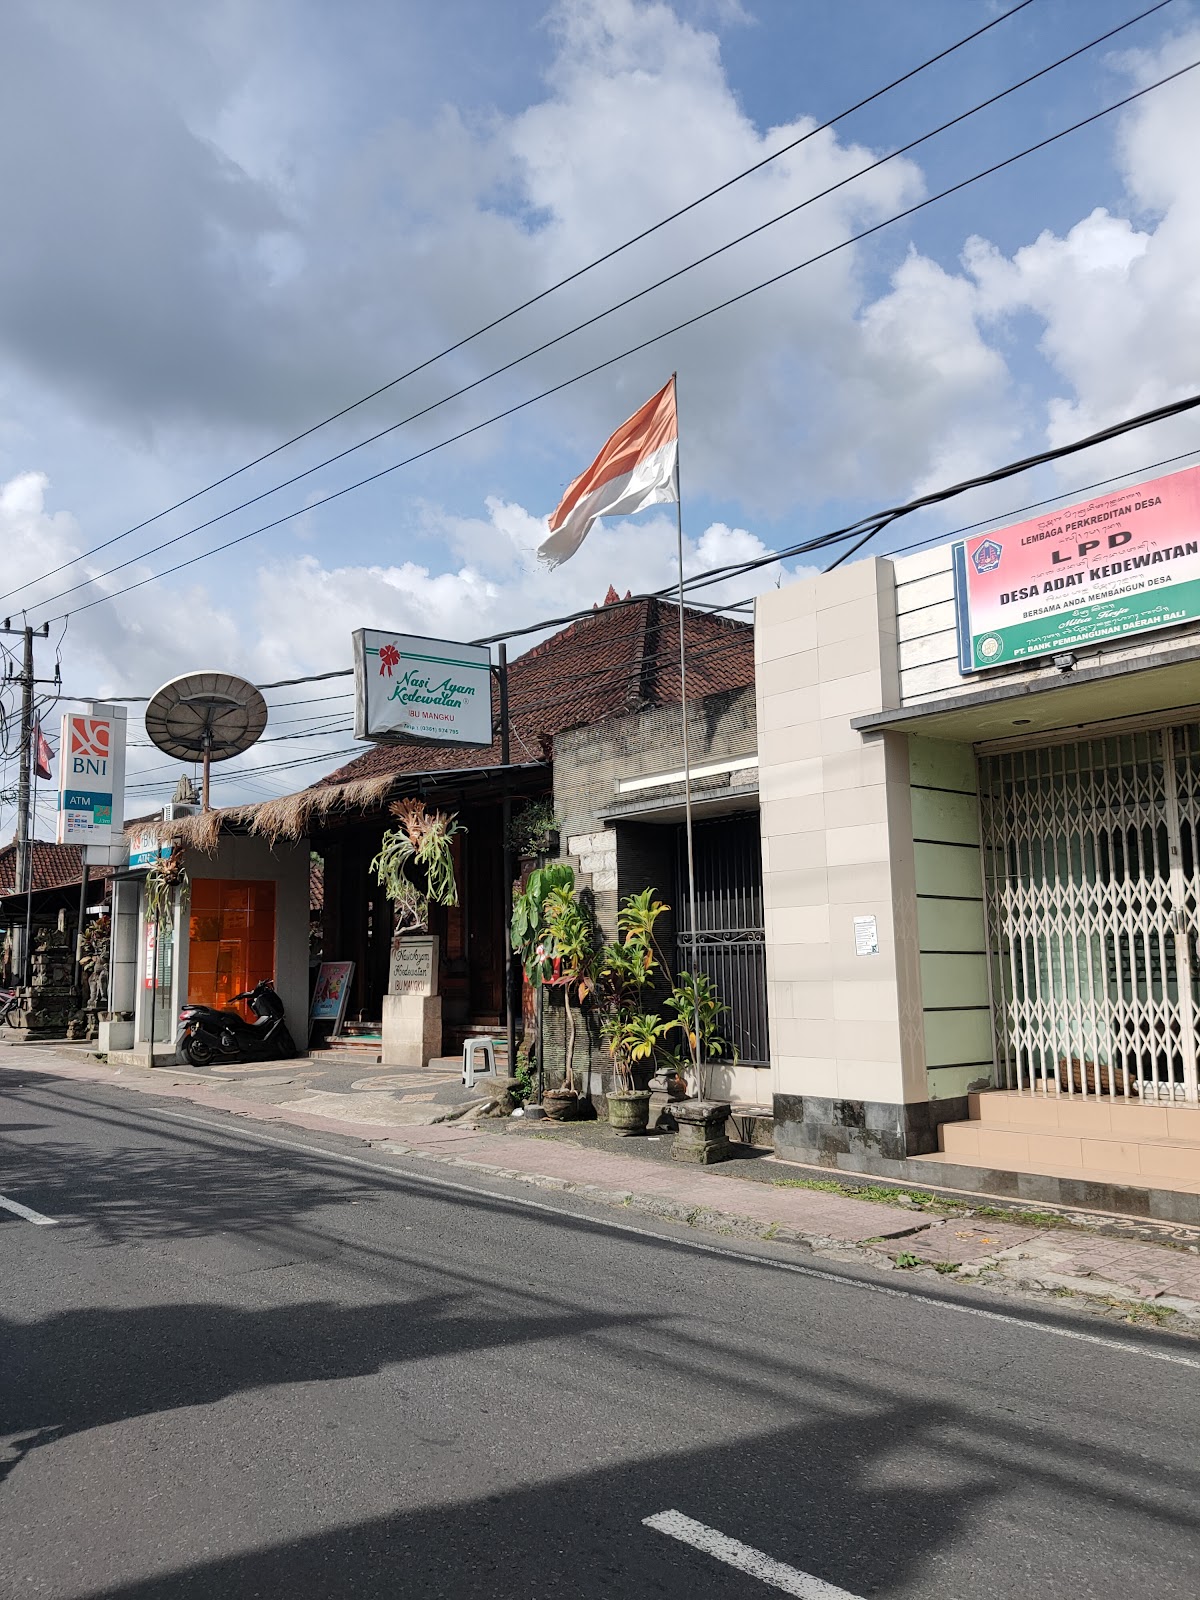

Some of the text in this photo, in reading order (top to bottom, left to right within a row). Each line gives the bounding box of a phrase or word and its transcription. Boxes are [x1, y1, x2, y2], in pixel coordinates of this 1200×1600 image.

[1021, 526, 1063, 546] LEMBAGA
[1065, 504, 1132, 533] PERKREDITAN
[1134, 496, 1162, 512] DESA
[1000, 584, 1039, 606] DESA
[1042, 571, 1085, 594] ADAT
[1089, 540, 1198, 581] KEDEWATAN
[1022, 604, 1061, 619] BERSAMA
[1063, 597, 1086, 608] ANDA
[1088, 581, 1145, 602] MEMBANGUN
[1147, 574, 1172, 587] DESA
[1013, 609, 1186, 656] PT. BANK PEMBANGUNAN DAERAH BALI
[397, 669, 475, 699] Nasi Ayam
[387, 685, 462, 708] Kedewatan
[408, 709, 455, 722] IBU MANGKU
[73, 757, 106, 776] BNI
[69, 796, 91, 806] ATM
[96, 805, 110, 817] 24
[403, 980, 425, 991] MANGKU
